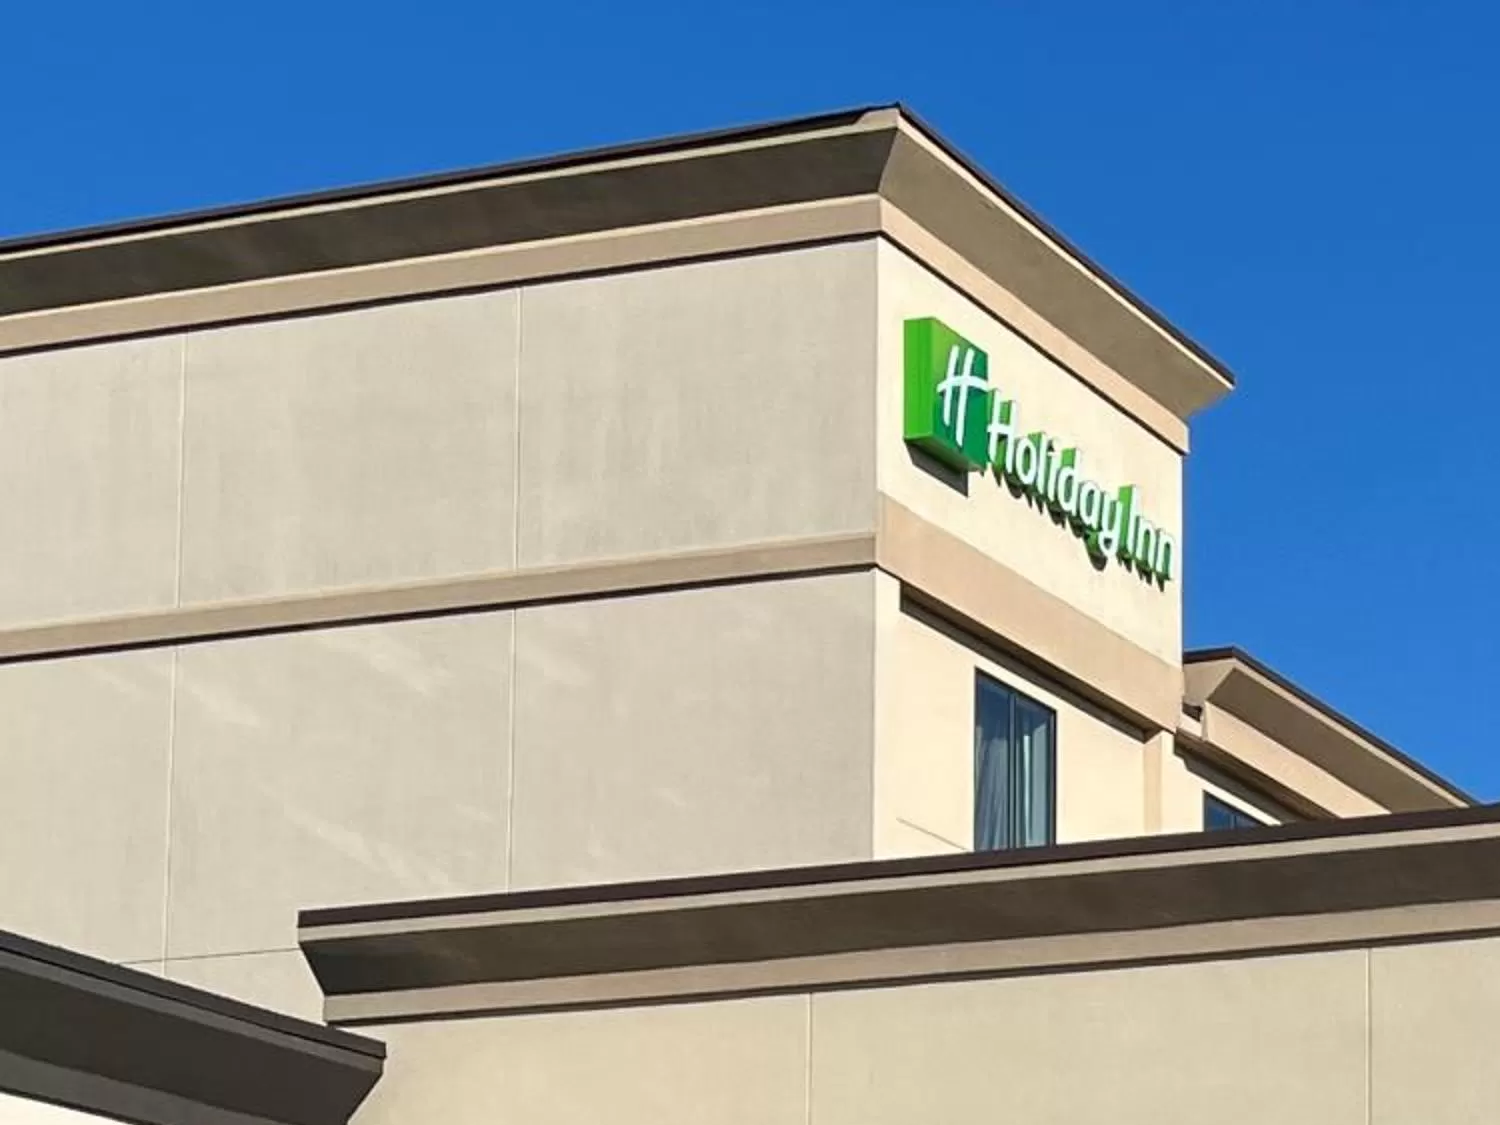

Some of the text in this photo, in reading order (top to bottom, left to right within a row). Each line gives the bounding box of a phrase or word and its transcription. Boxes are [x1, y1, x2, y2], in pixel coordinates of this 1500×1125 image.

[936, 345, 990, 448] H
[986, 388, 1175, 578] Holiday Inn
